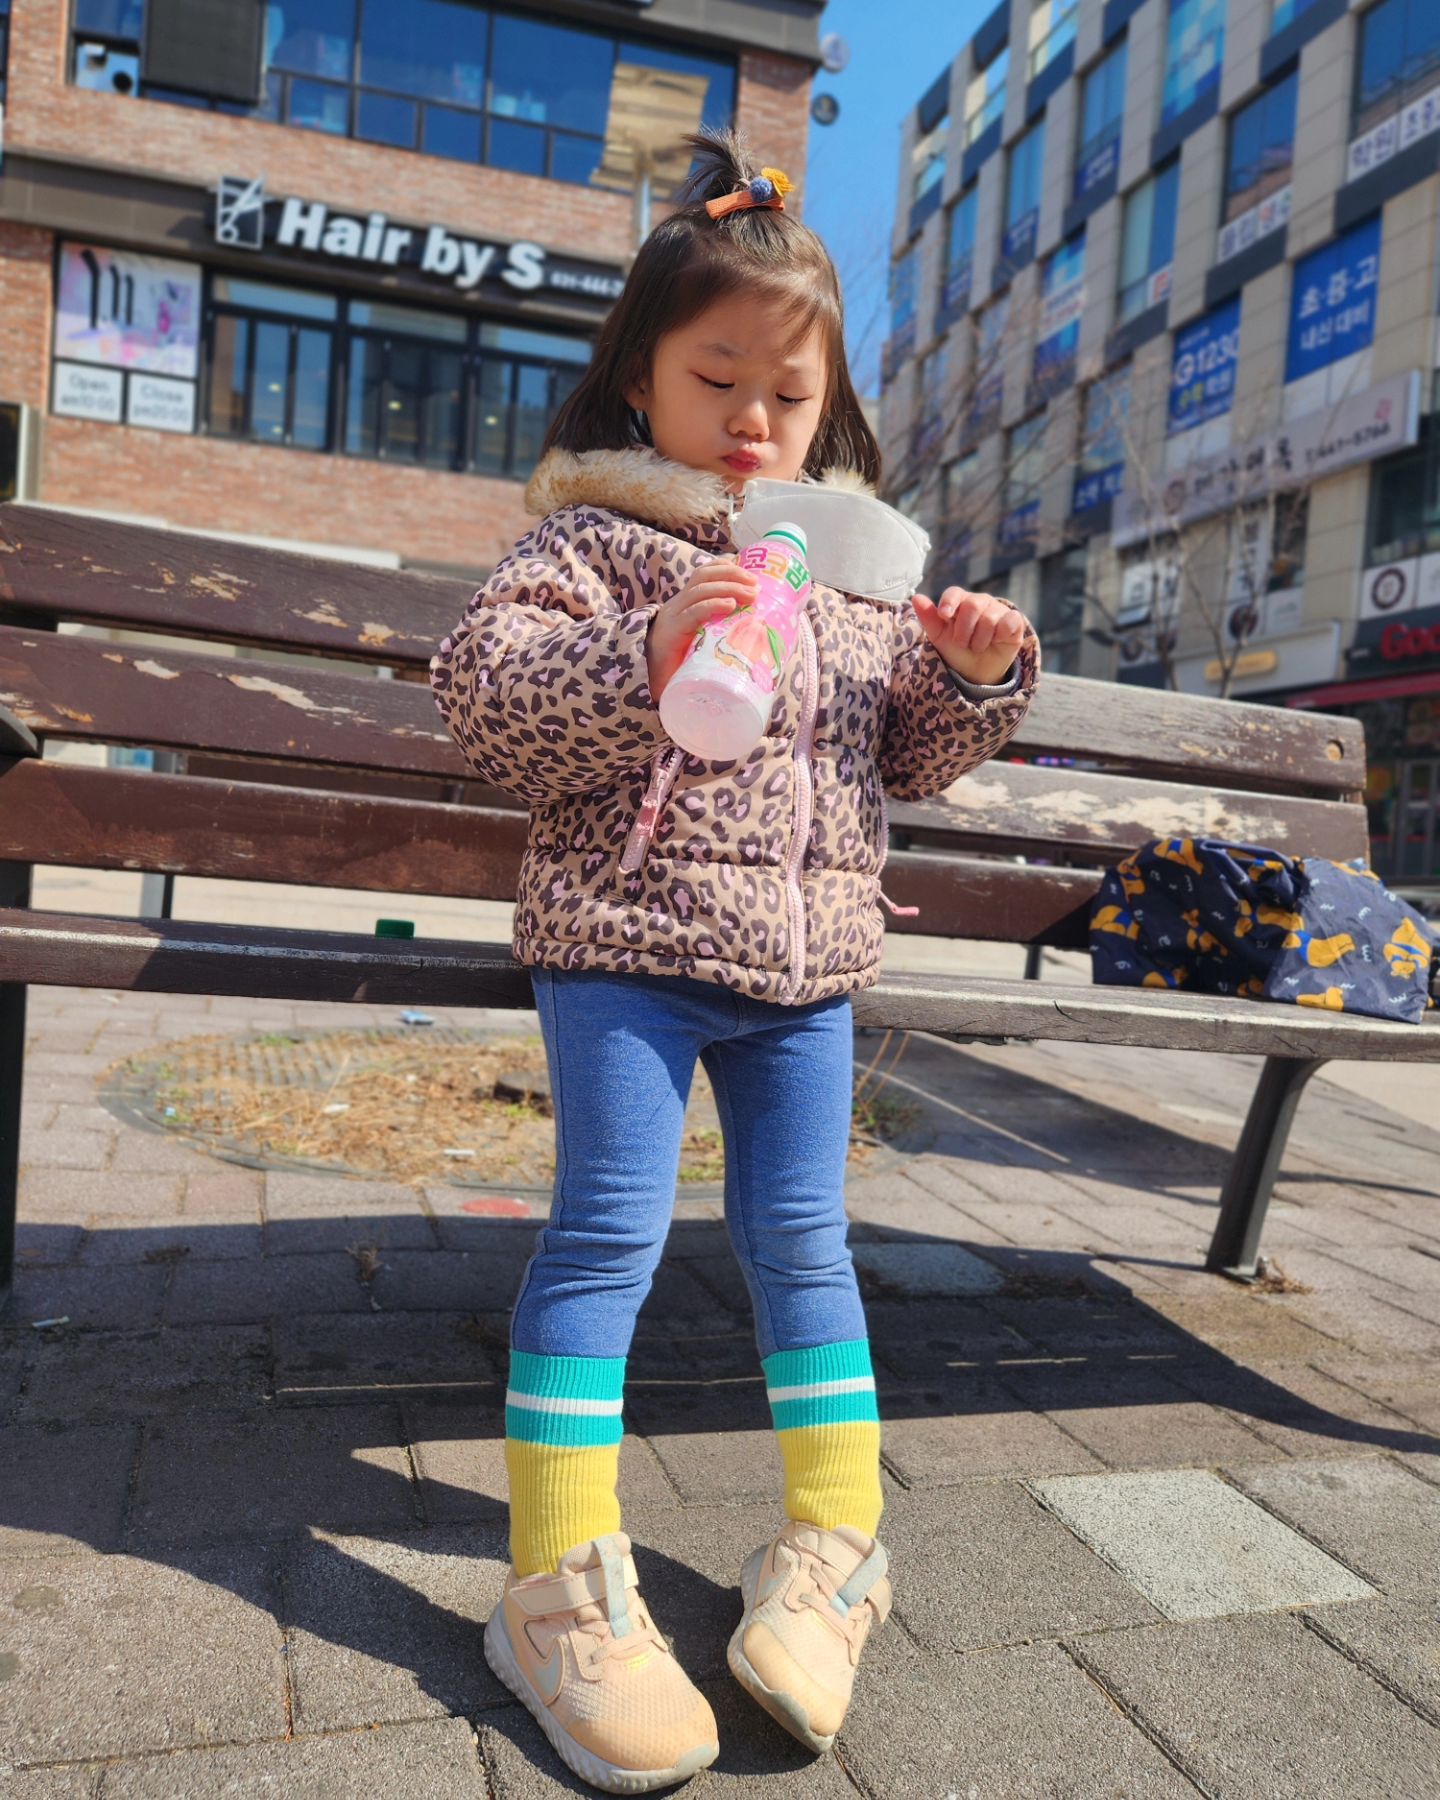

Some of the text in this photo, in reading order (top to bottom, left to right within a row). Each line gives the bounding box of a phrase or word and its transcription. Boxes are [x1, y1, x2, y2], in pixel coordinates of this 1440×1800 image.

[277, 199, 411, 264] Hair
[421, 224, 494, 288] by
[502, 241, 546, 289] S
[69, 373, 110, 391] Open
[141, 384, 184, 402] Close
